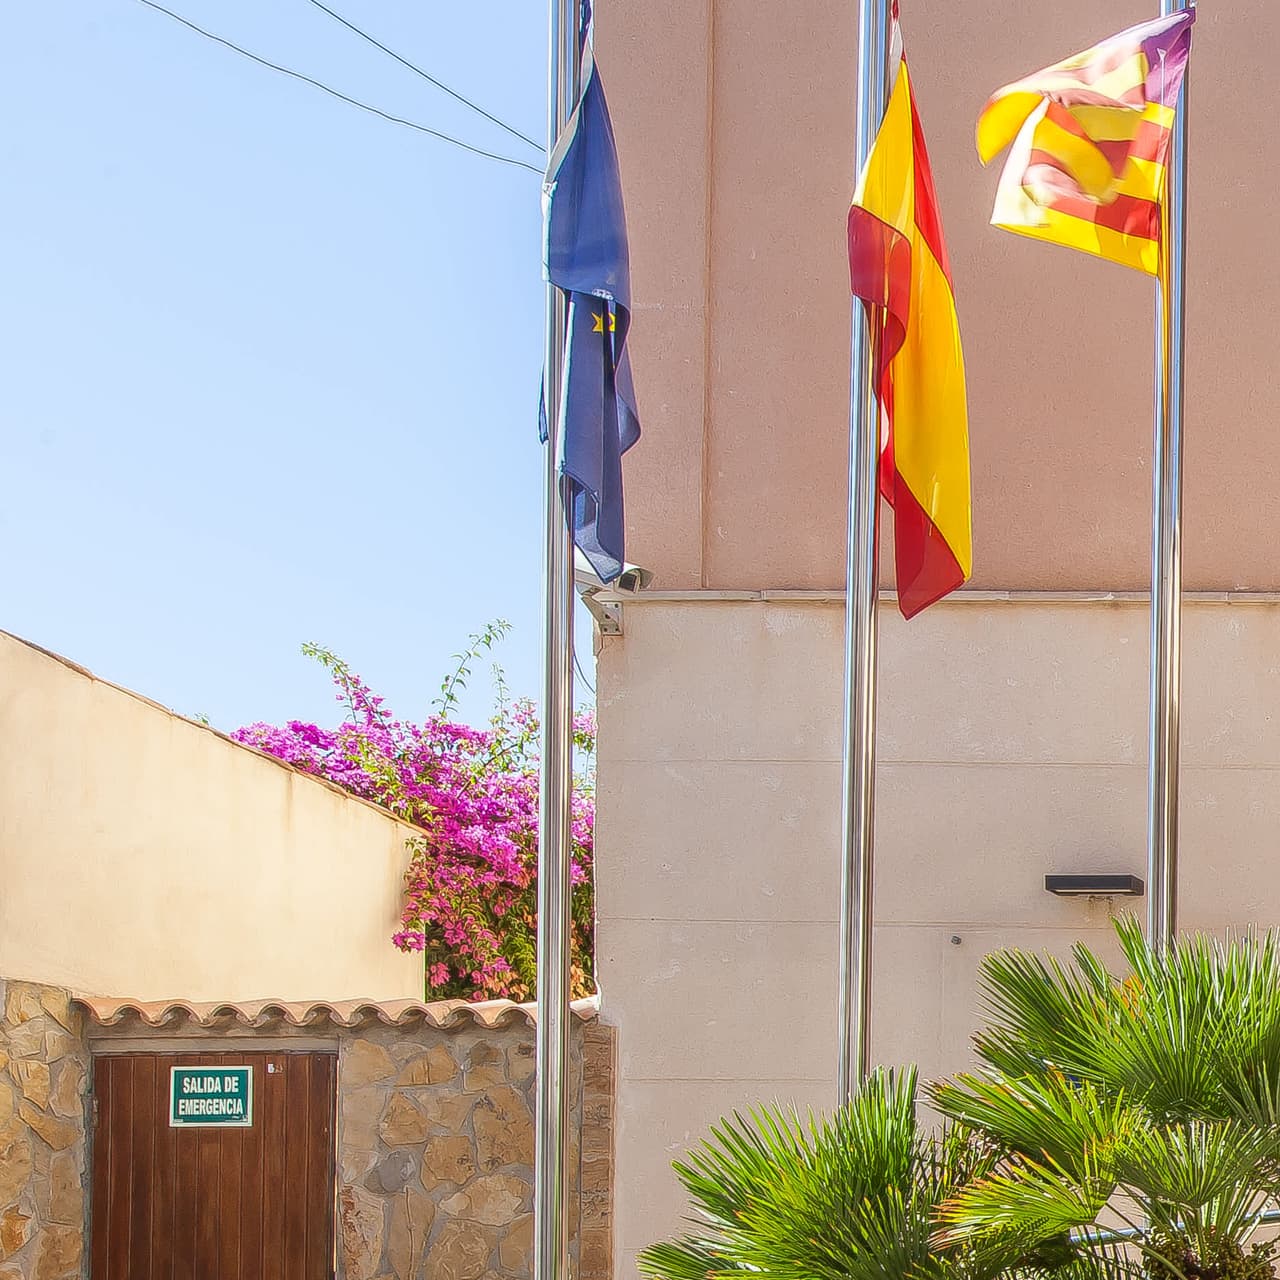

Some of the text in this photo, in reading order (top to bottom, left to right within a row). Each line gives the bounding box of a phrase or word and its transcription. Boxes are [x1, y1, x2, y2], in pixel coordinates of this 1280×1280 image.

[182, 1076, 240, 1094] SALIDA DE
[178, 1098, 244, 1116] EMERGENCIA
